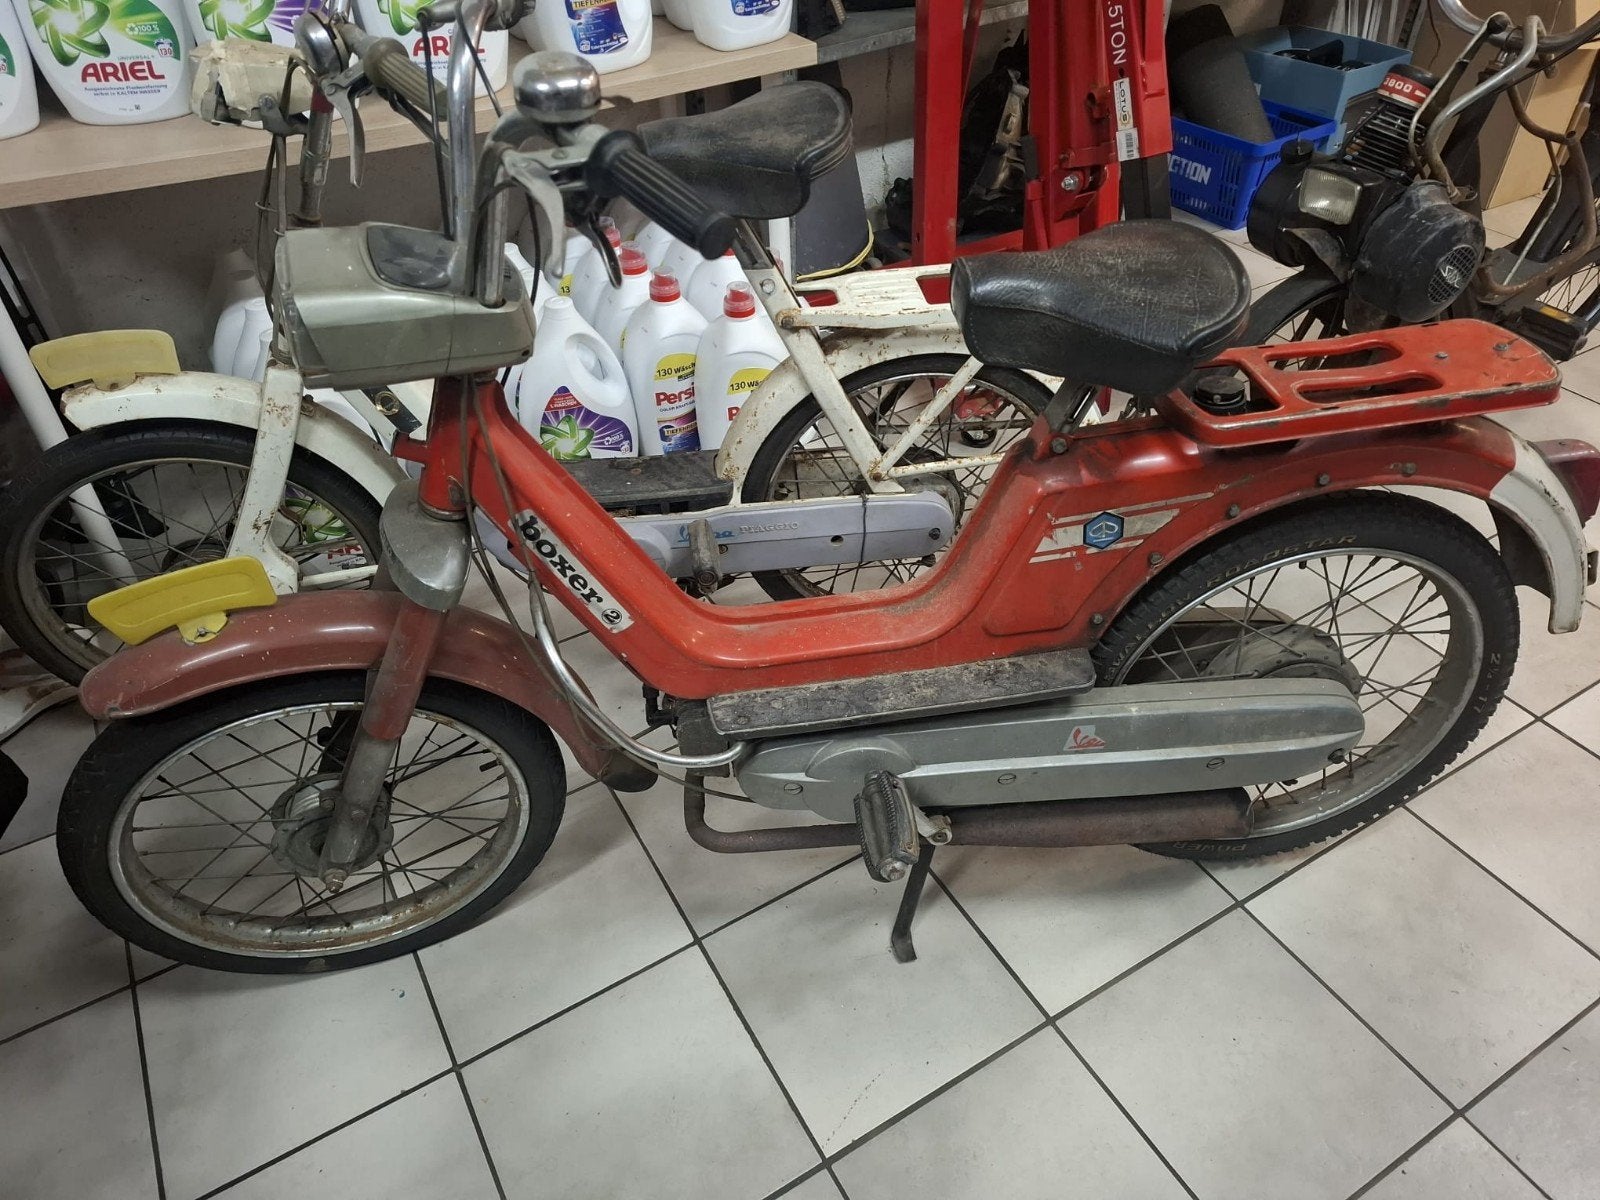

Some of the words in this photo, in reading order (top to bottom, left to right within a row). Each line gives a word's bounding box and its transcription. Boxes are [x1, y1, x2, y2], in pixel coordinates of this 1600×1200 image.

[81, 60, 165, 82] ARIEL
[656, 367, 673, 377] 130
[730, 381, 746, 391] 130
[740, 522, 798, 533] PIAGGIO
[520, 515, 603, 603] boxer
[603, 609, 621, 623] 2
